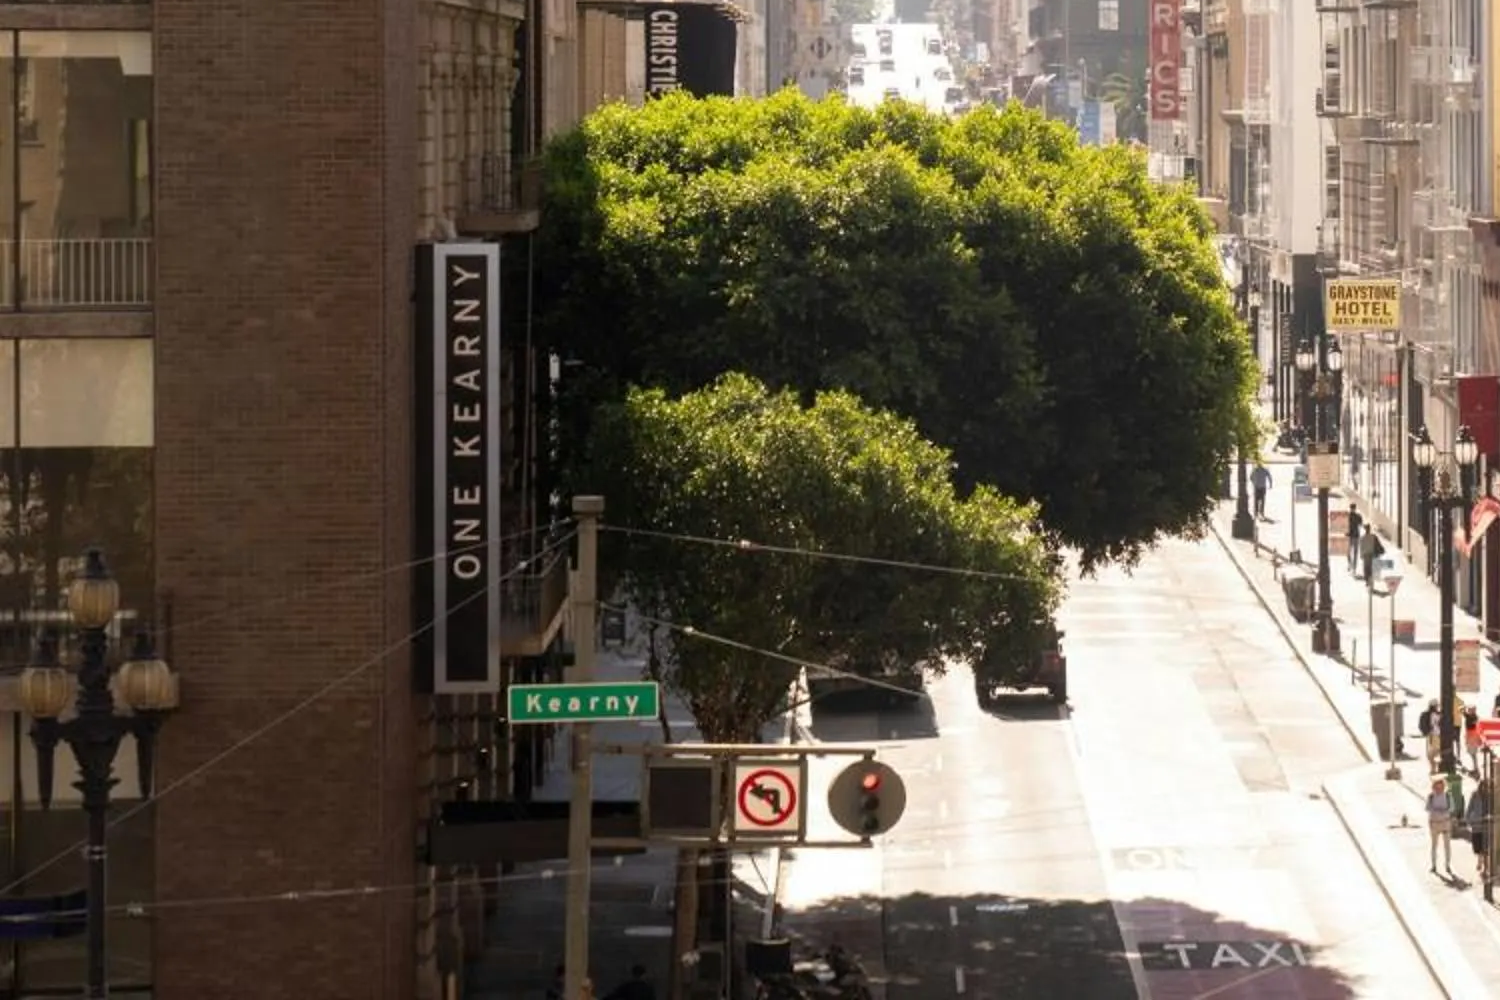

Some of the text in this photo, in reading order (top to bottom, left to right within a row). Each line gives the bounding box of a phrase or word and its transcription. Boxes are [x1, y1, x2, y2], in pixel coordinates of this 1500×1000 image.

[1329, 285, 1397, 301] GRAYSTONE
[1335, 301, 1392, 316] HOTEL
[453, 264, 482, 581] ONE KEARNY
[526, 692, 641, 716] Kearny
[1162, 941, 1309, 969] TAXI
